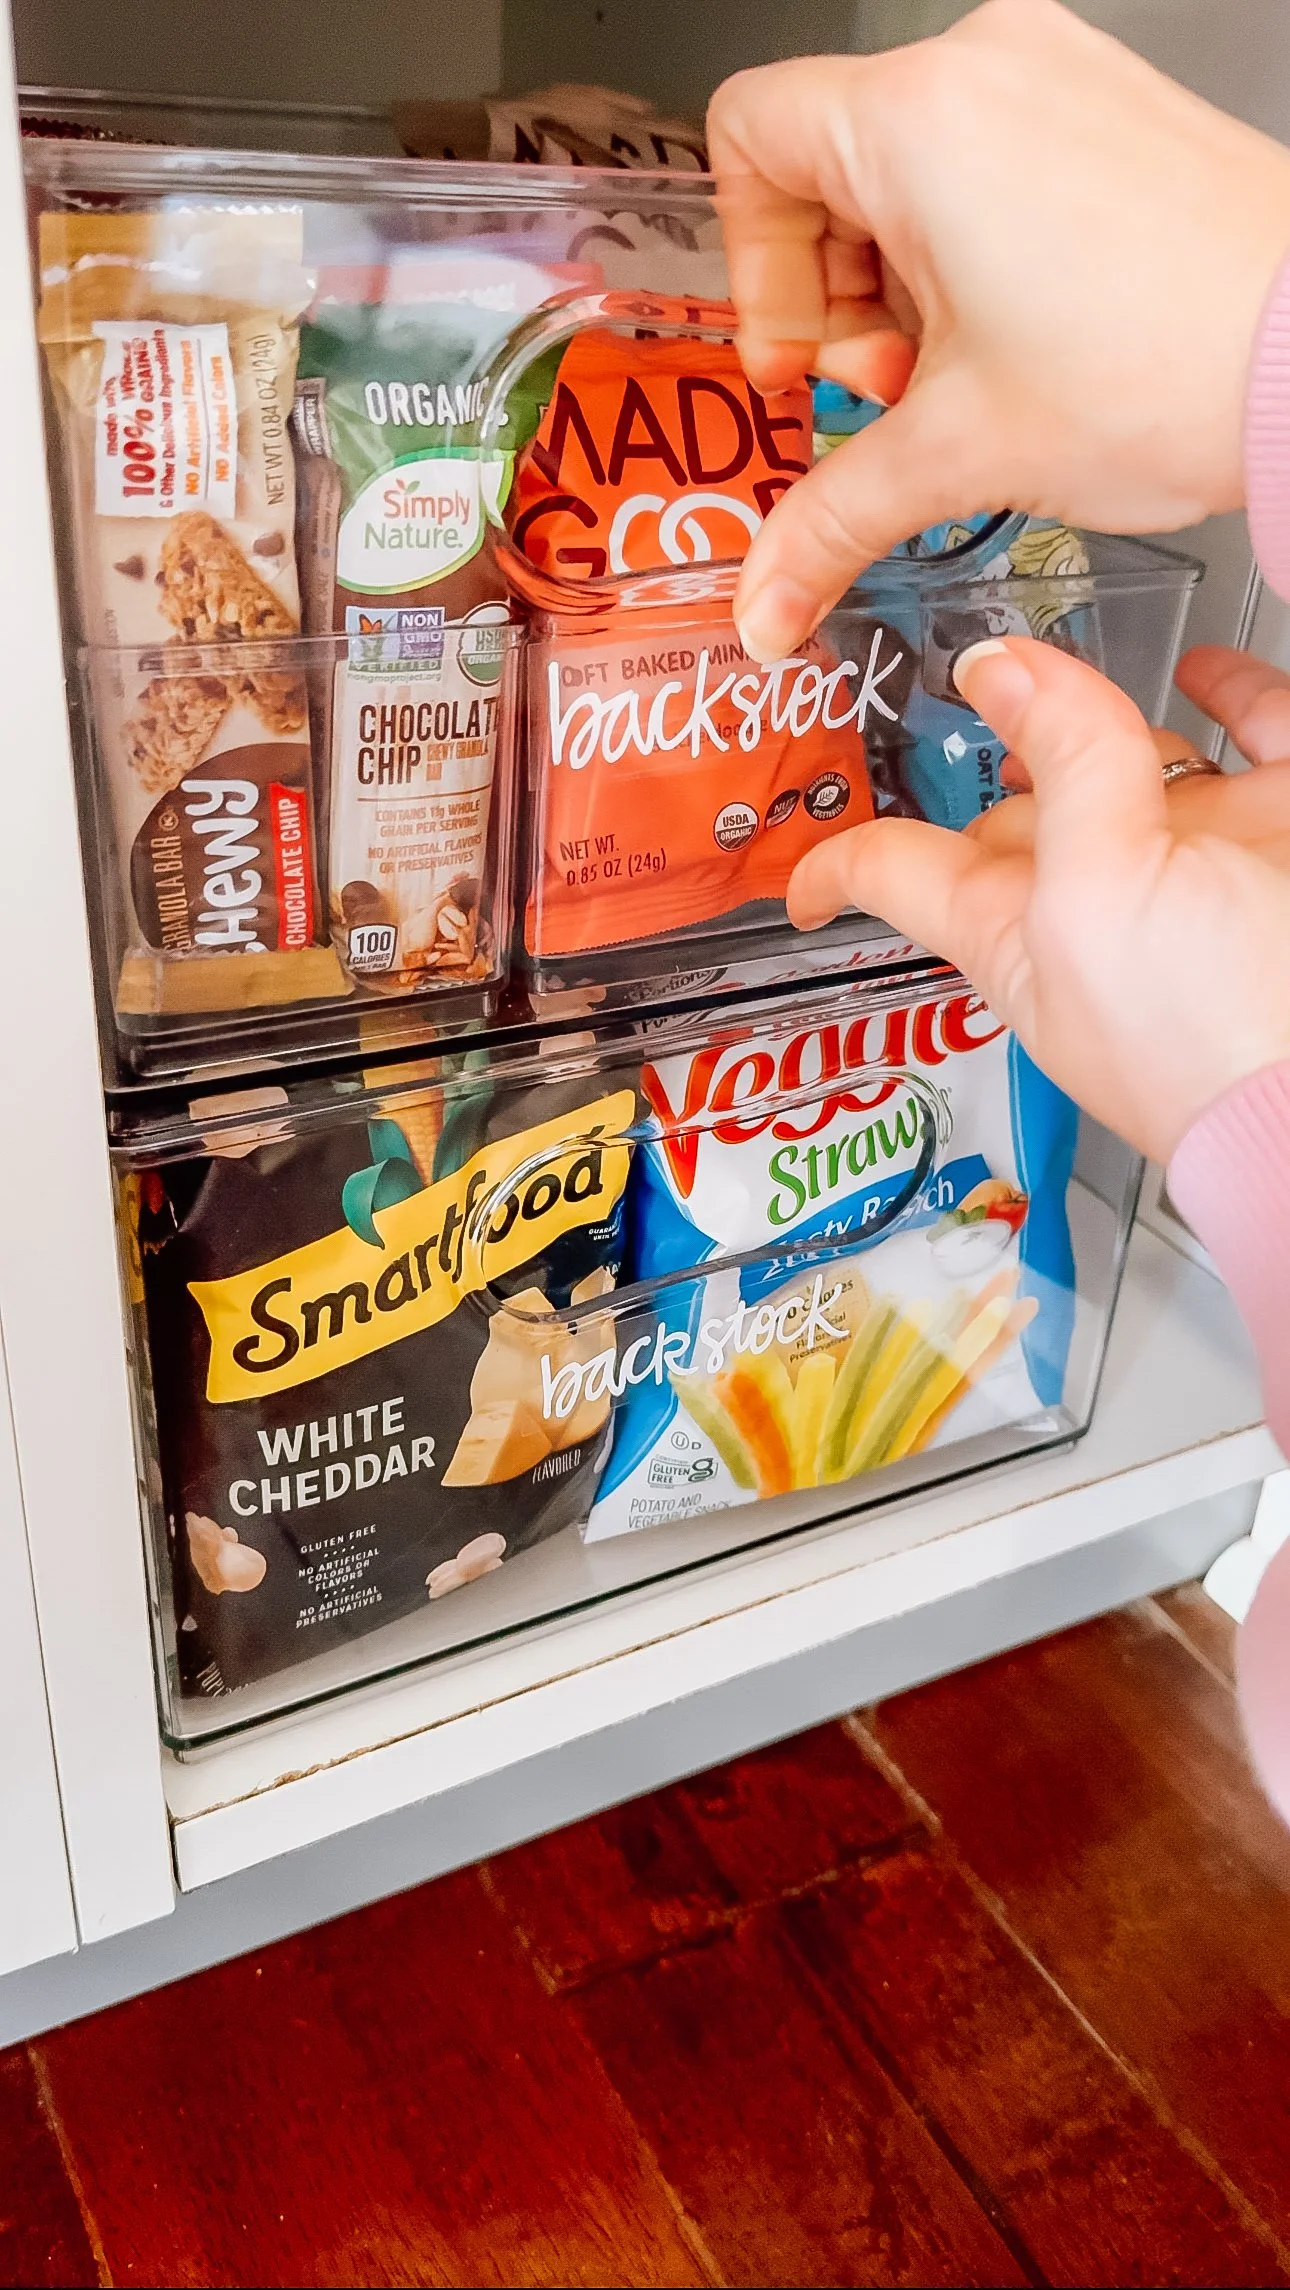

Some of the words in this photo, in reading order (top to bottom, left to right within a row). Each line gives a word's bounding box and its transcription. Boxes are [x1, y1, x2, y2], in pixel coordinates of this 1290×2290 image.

[256, 375, 278, 401] OZ
[261, 404, 282, 438] 0.84
[122, 409, 156, 498] 100%
[263, 443, 283, 470] WT
[185, 472, 199, 495] NO
[215, 459, 229, 481] NO
[265, 473, 285, 506] NET
[383, 489, 471, 526] Simply
[402, 613, 439, 627] NON
[404, 631, 441, 644] GMO
[621, 651, 695, 681] BAKED
[549, 627, 903, 770] backstock
[359, 696, 499, 745] CHOCOLAT
[357, 745, 421, 785] CHIP
[977, 747, 993, 786] OAT
[278, 798, 302, 841] CHIP
[448, 799, 480, 816] WHOLE
[722, 813, 750, 828] USDA
[416, 821, 437, 834] PER
[720, 827, 752, 841] ORGANIC
[151, 835, 184, 873] BAR
[398, 850, 474, 873] PRESERVATIVES
[560, 839, 590, 861] NET
[595, 834, 620, 856] WT.
[566, 863, 598, 887] 0.85
[603, 858, 622, 878] OZ
[628, 847, 667, 878] (24g)
[281, 846, 307, 945] CHOCOLATE
[357, 931, 391, 954] 100
[353, 953, 390, 965] CALORIES
[232, 1125, 606, 1374] Smartfood
[541, 1274, 850, 1419] backstock
[257, 1396, 405, 1466] WHITE
[229, 1436, 436, 1517] CHEDDAR
[652, 1474, 674, 1484] FREE
[653, 1463, 691, 1476] GLUTEN
[630, 1497, 676, 1513] POTATO
[678, 1493, 702, 1509] AND
[301, 1535, 344, 1554] GLUTEN
[349, 1524, 377, 1541] FREE
[298, 1566, 314, 1577] NO
[319, 1548, 379, 1573] ARTIFICIAL
[308, 1565, 351, 1584] COLORS
[356, 1559, 370, 1570] OR
[315, 1570, 363, 1592] FLAVORS
[296, 1592, 383, 1629] PRESERVATIVES
[300, 1606, 315, 1619] NO
[319, 1585, 378, 1612] ARTIFICIAL
